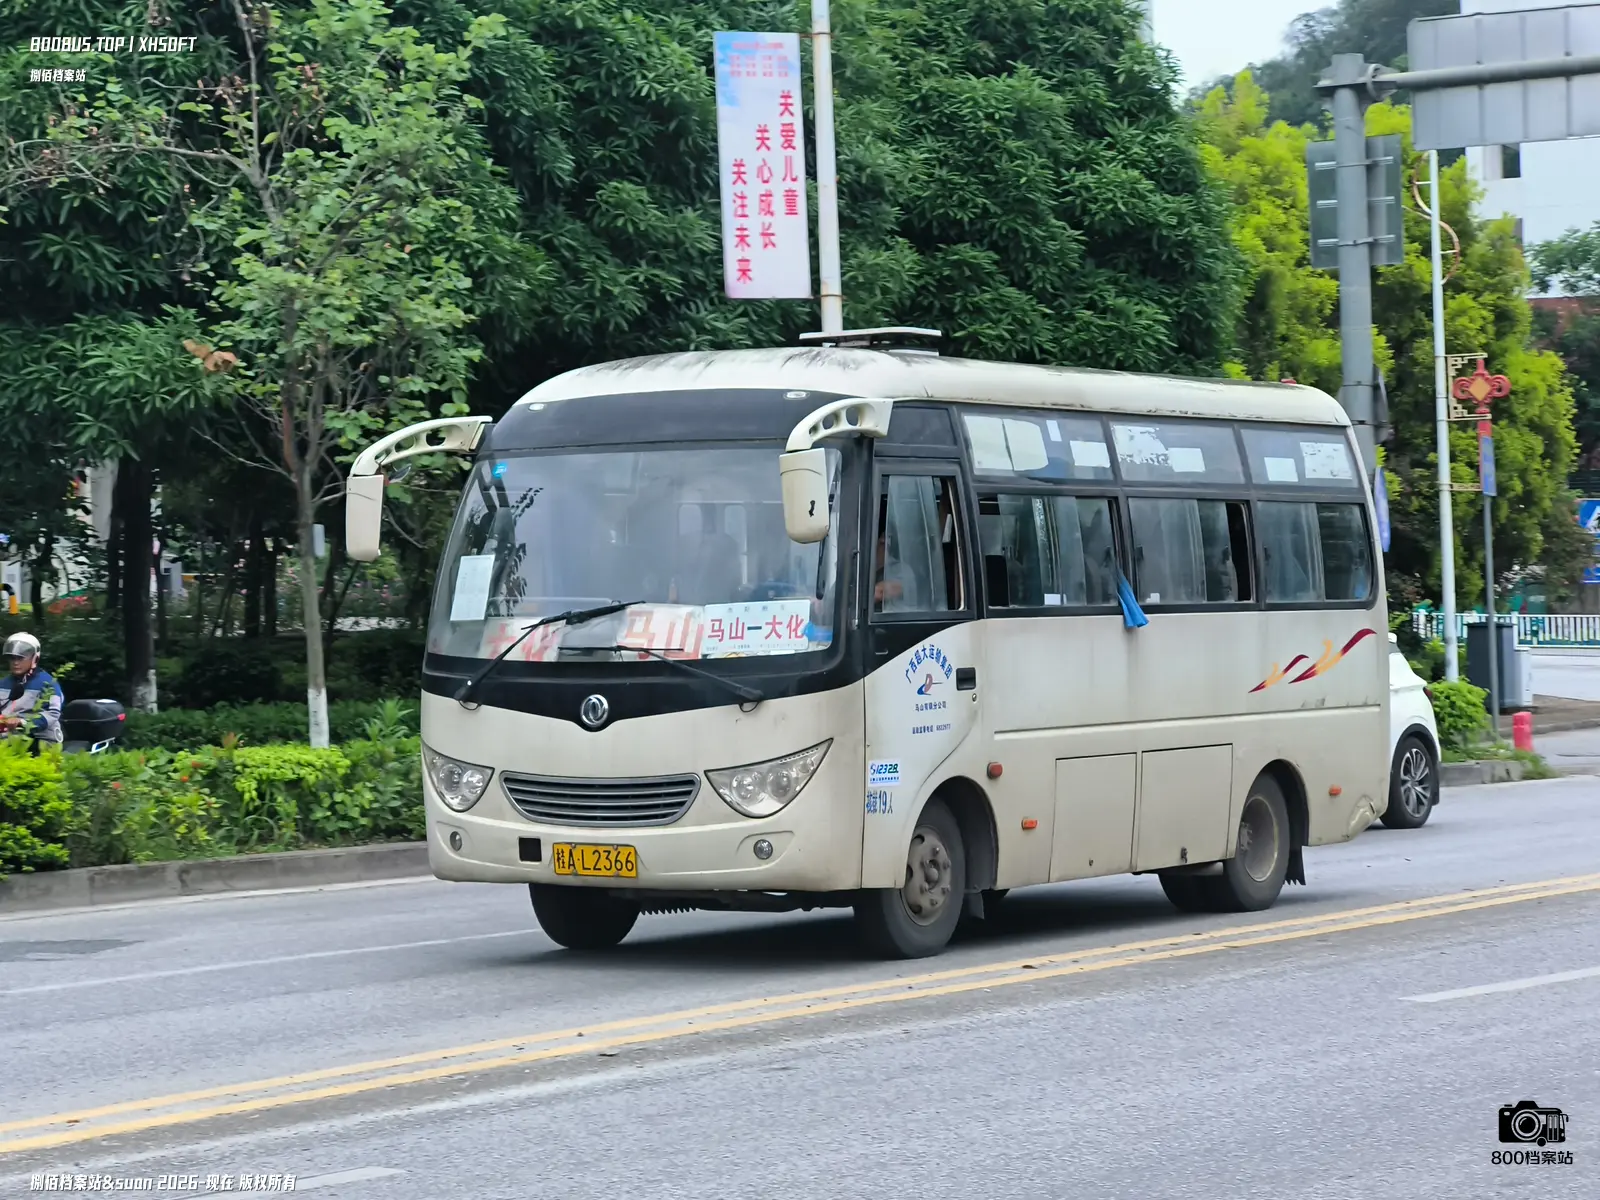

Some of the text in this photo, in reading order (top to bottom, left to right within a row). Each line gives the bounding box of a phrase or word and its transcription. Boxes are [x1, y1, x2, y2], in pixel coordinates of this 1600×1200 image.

[755, 124, 777, 250] 关心成长
[779, 90, 799, 216] 关爱儿童
[732, 158, 753, 284] 关注未来
